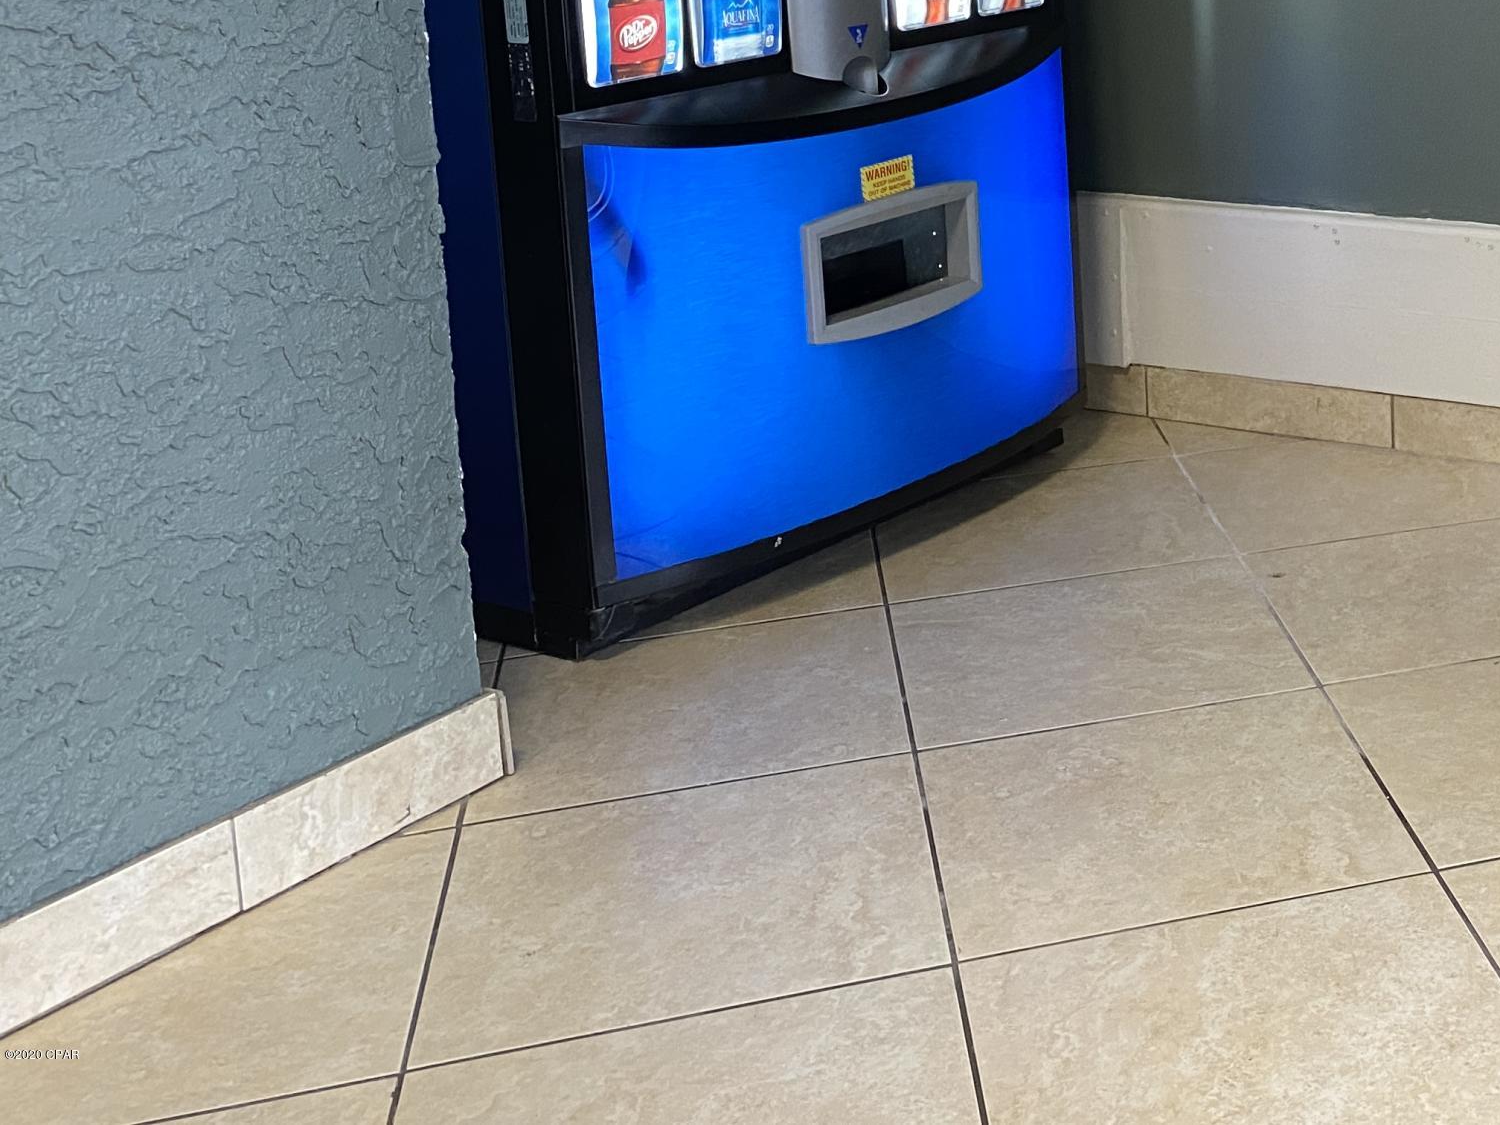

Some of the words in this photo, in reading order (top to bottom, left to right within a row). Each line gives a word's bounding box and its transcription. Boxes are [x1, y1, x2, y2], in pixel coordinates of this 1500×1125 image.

[722, 6, 760, 27] AQUAFINA
[621, 23, 657, 46] Pepper
[865, 159, 910, 182] WARNING!
